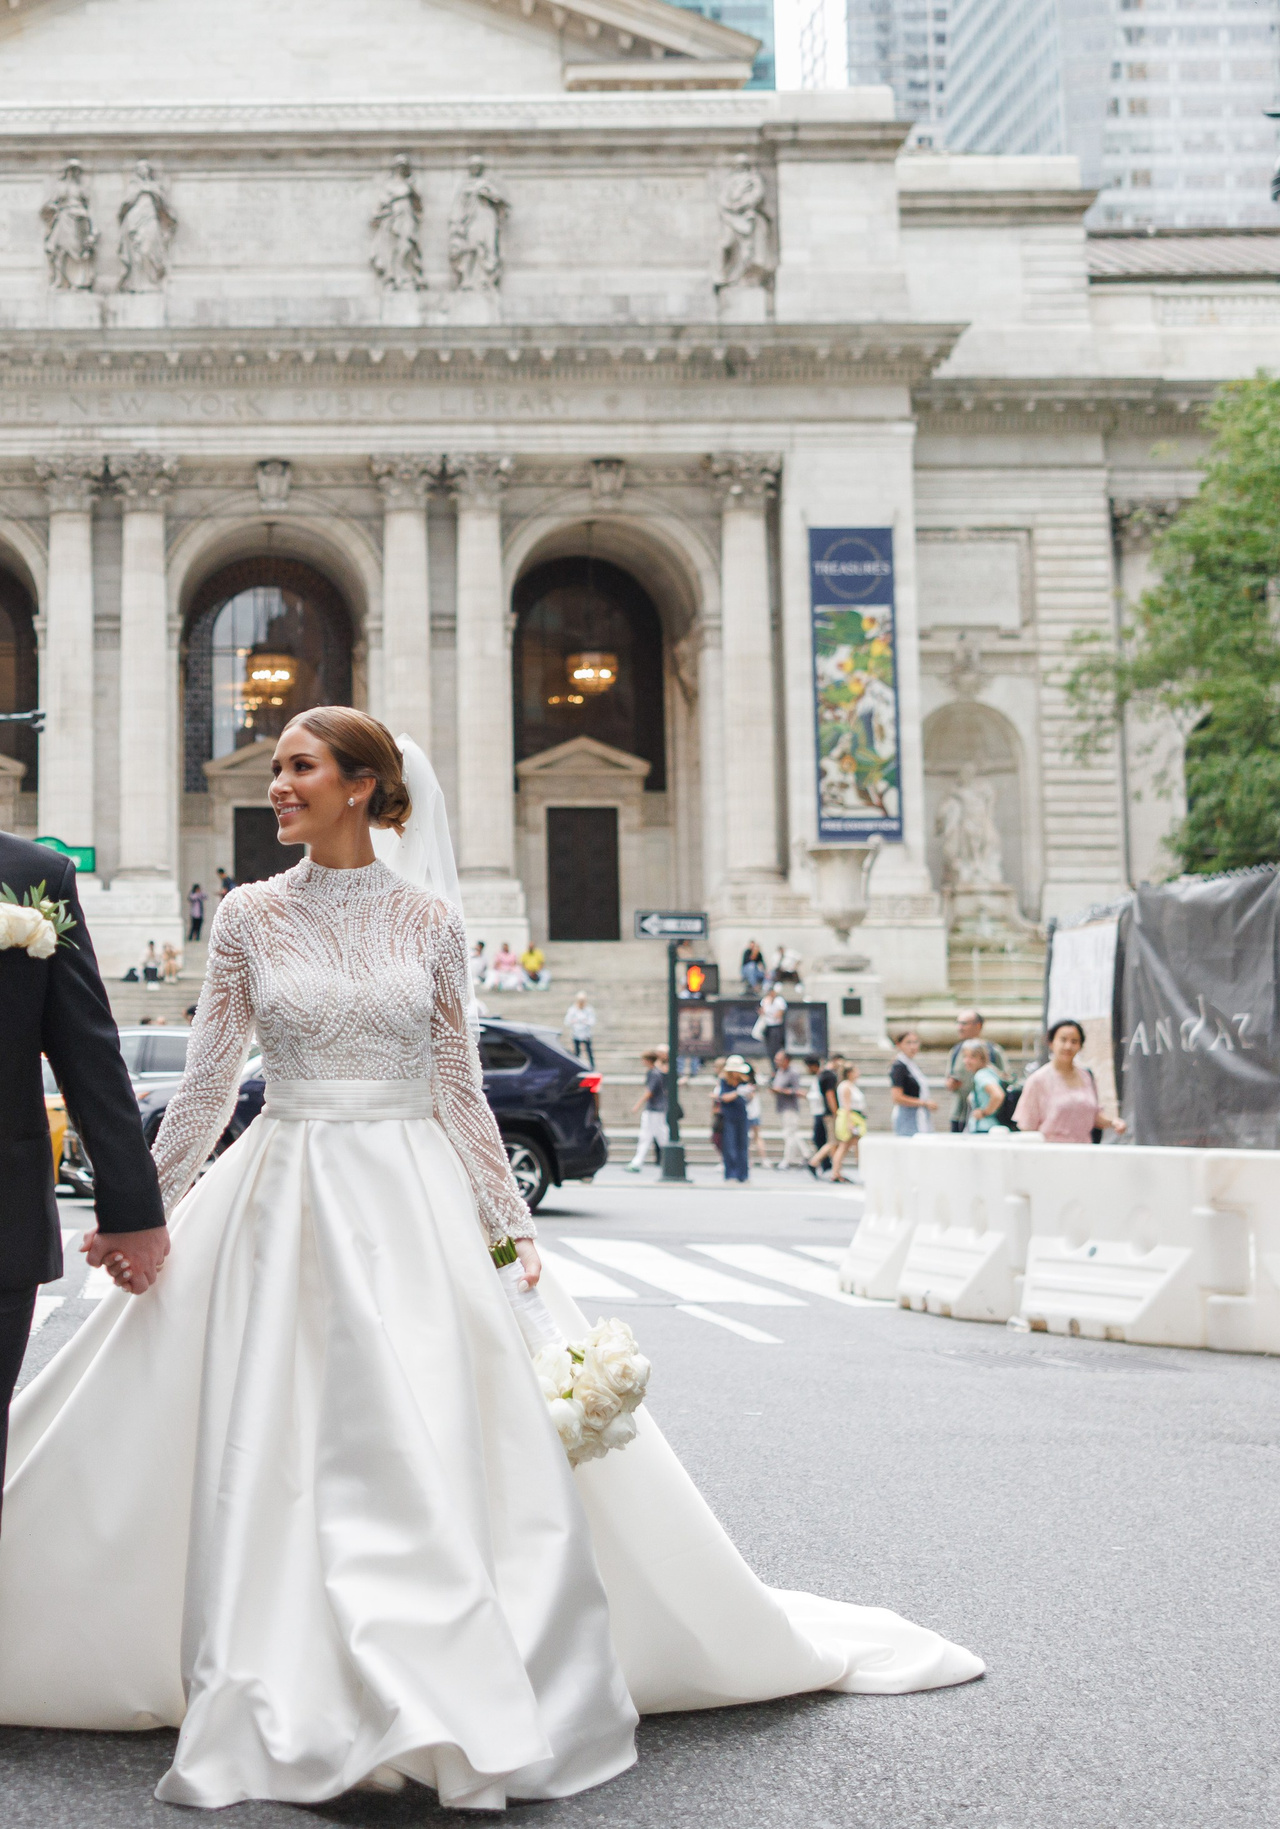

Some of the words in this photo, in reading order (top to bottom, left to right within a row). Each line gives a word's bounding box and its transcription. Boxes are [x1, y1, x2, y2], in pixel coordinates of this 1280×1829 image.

[178, 392, 264, 417] YORK
[292, 391, 408, 416] PUBLIC
[439, 390, 575, 416] LIBRARY
